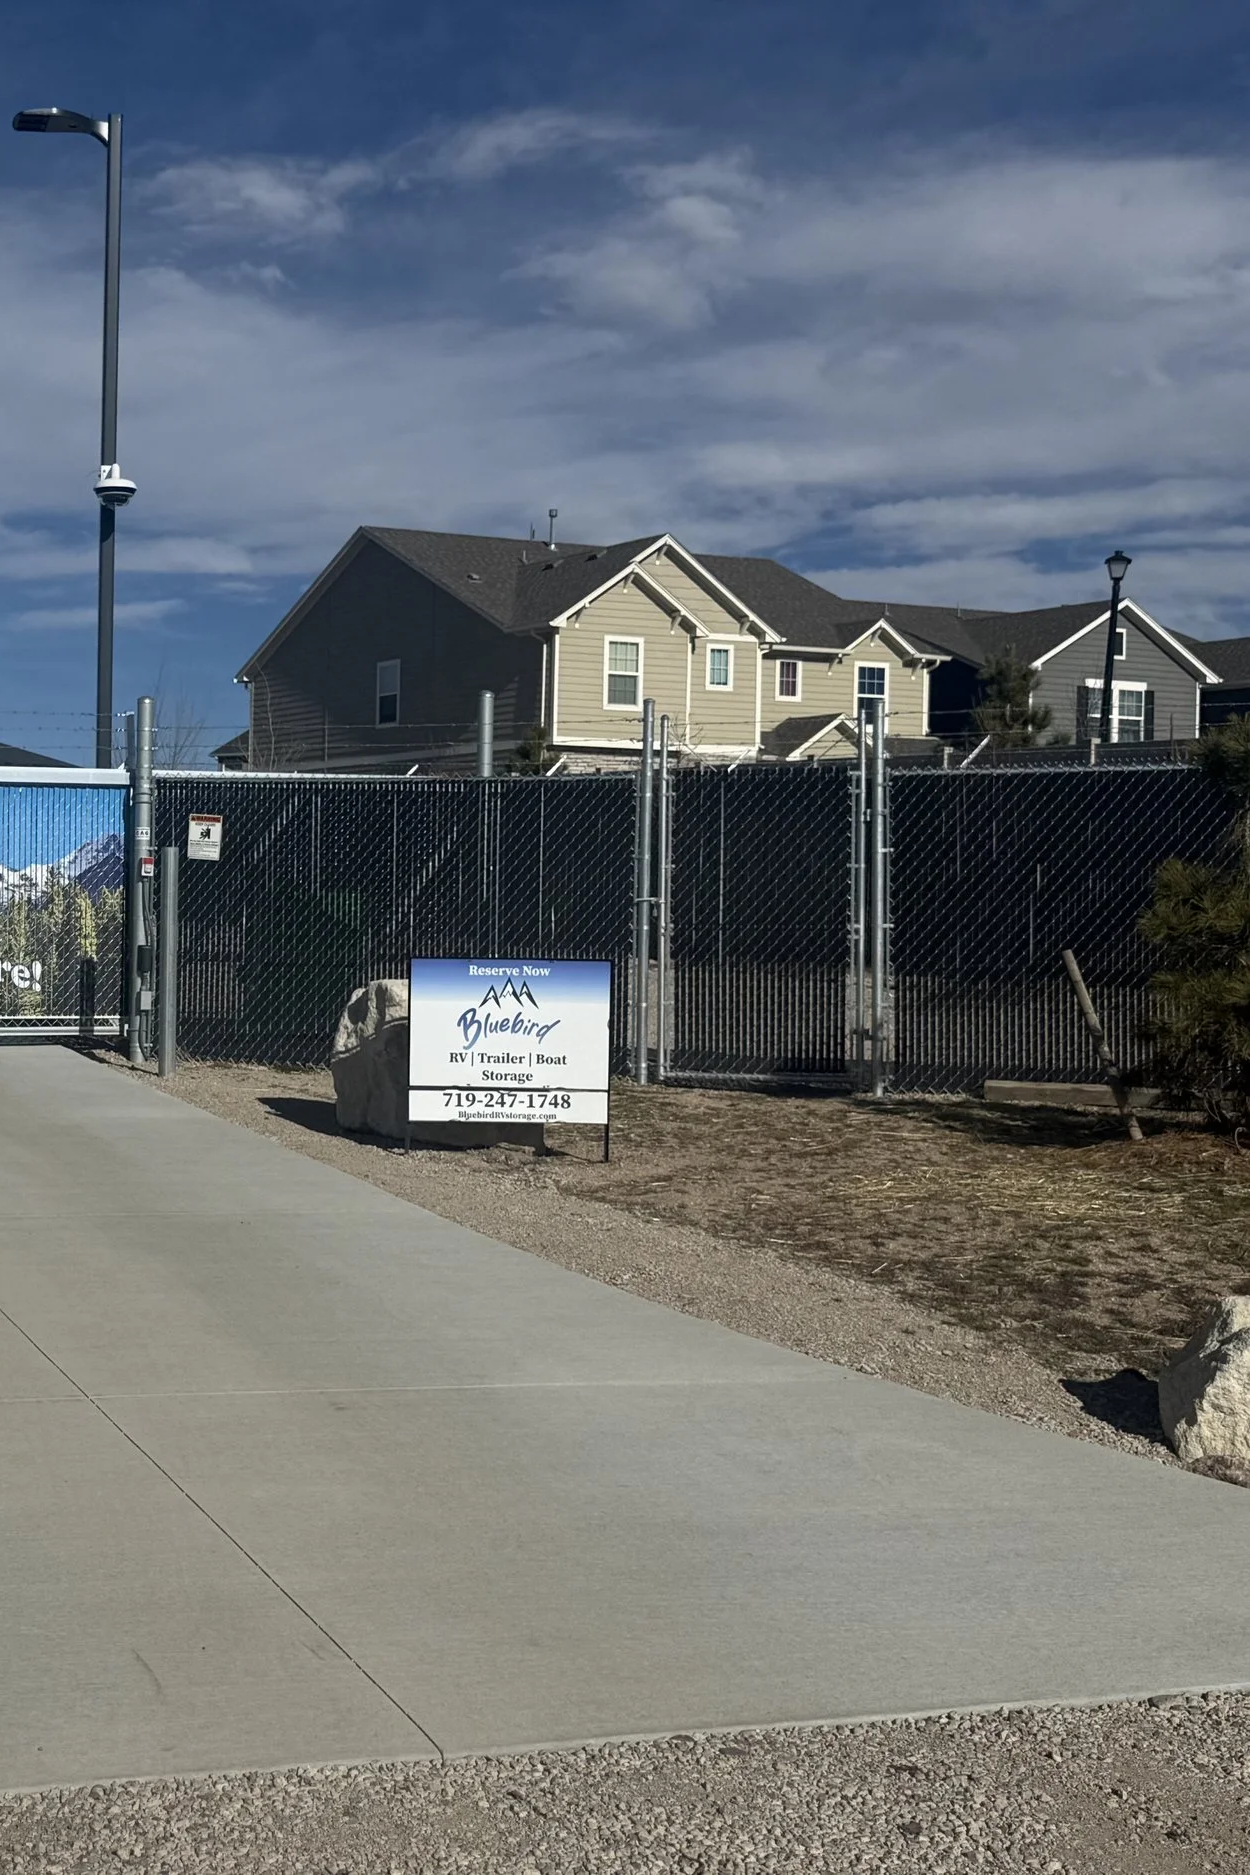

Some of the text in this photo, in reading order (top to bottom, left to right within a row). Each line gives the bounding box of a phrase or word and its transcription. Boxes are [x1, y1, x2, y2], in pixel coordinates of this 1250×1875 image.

[469, 964, 551, 977] Reserve Now
[456, 1007, 561, 1051] Bluebird
[449, 1052, 468, 1063] RV
[477, 1052, 526, 1064] Trailer
[536, 1053, 568, 1065] Boat
[481, 1070, 534, 1084] Storage
[442, 1092, 572, 1109] 719-247-1748
[457, 1110, 557, 1120] BluebirdRVstorage.com
